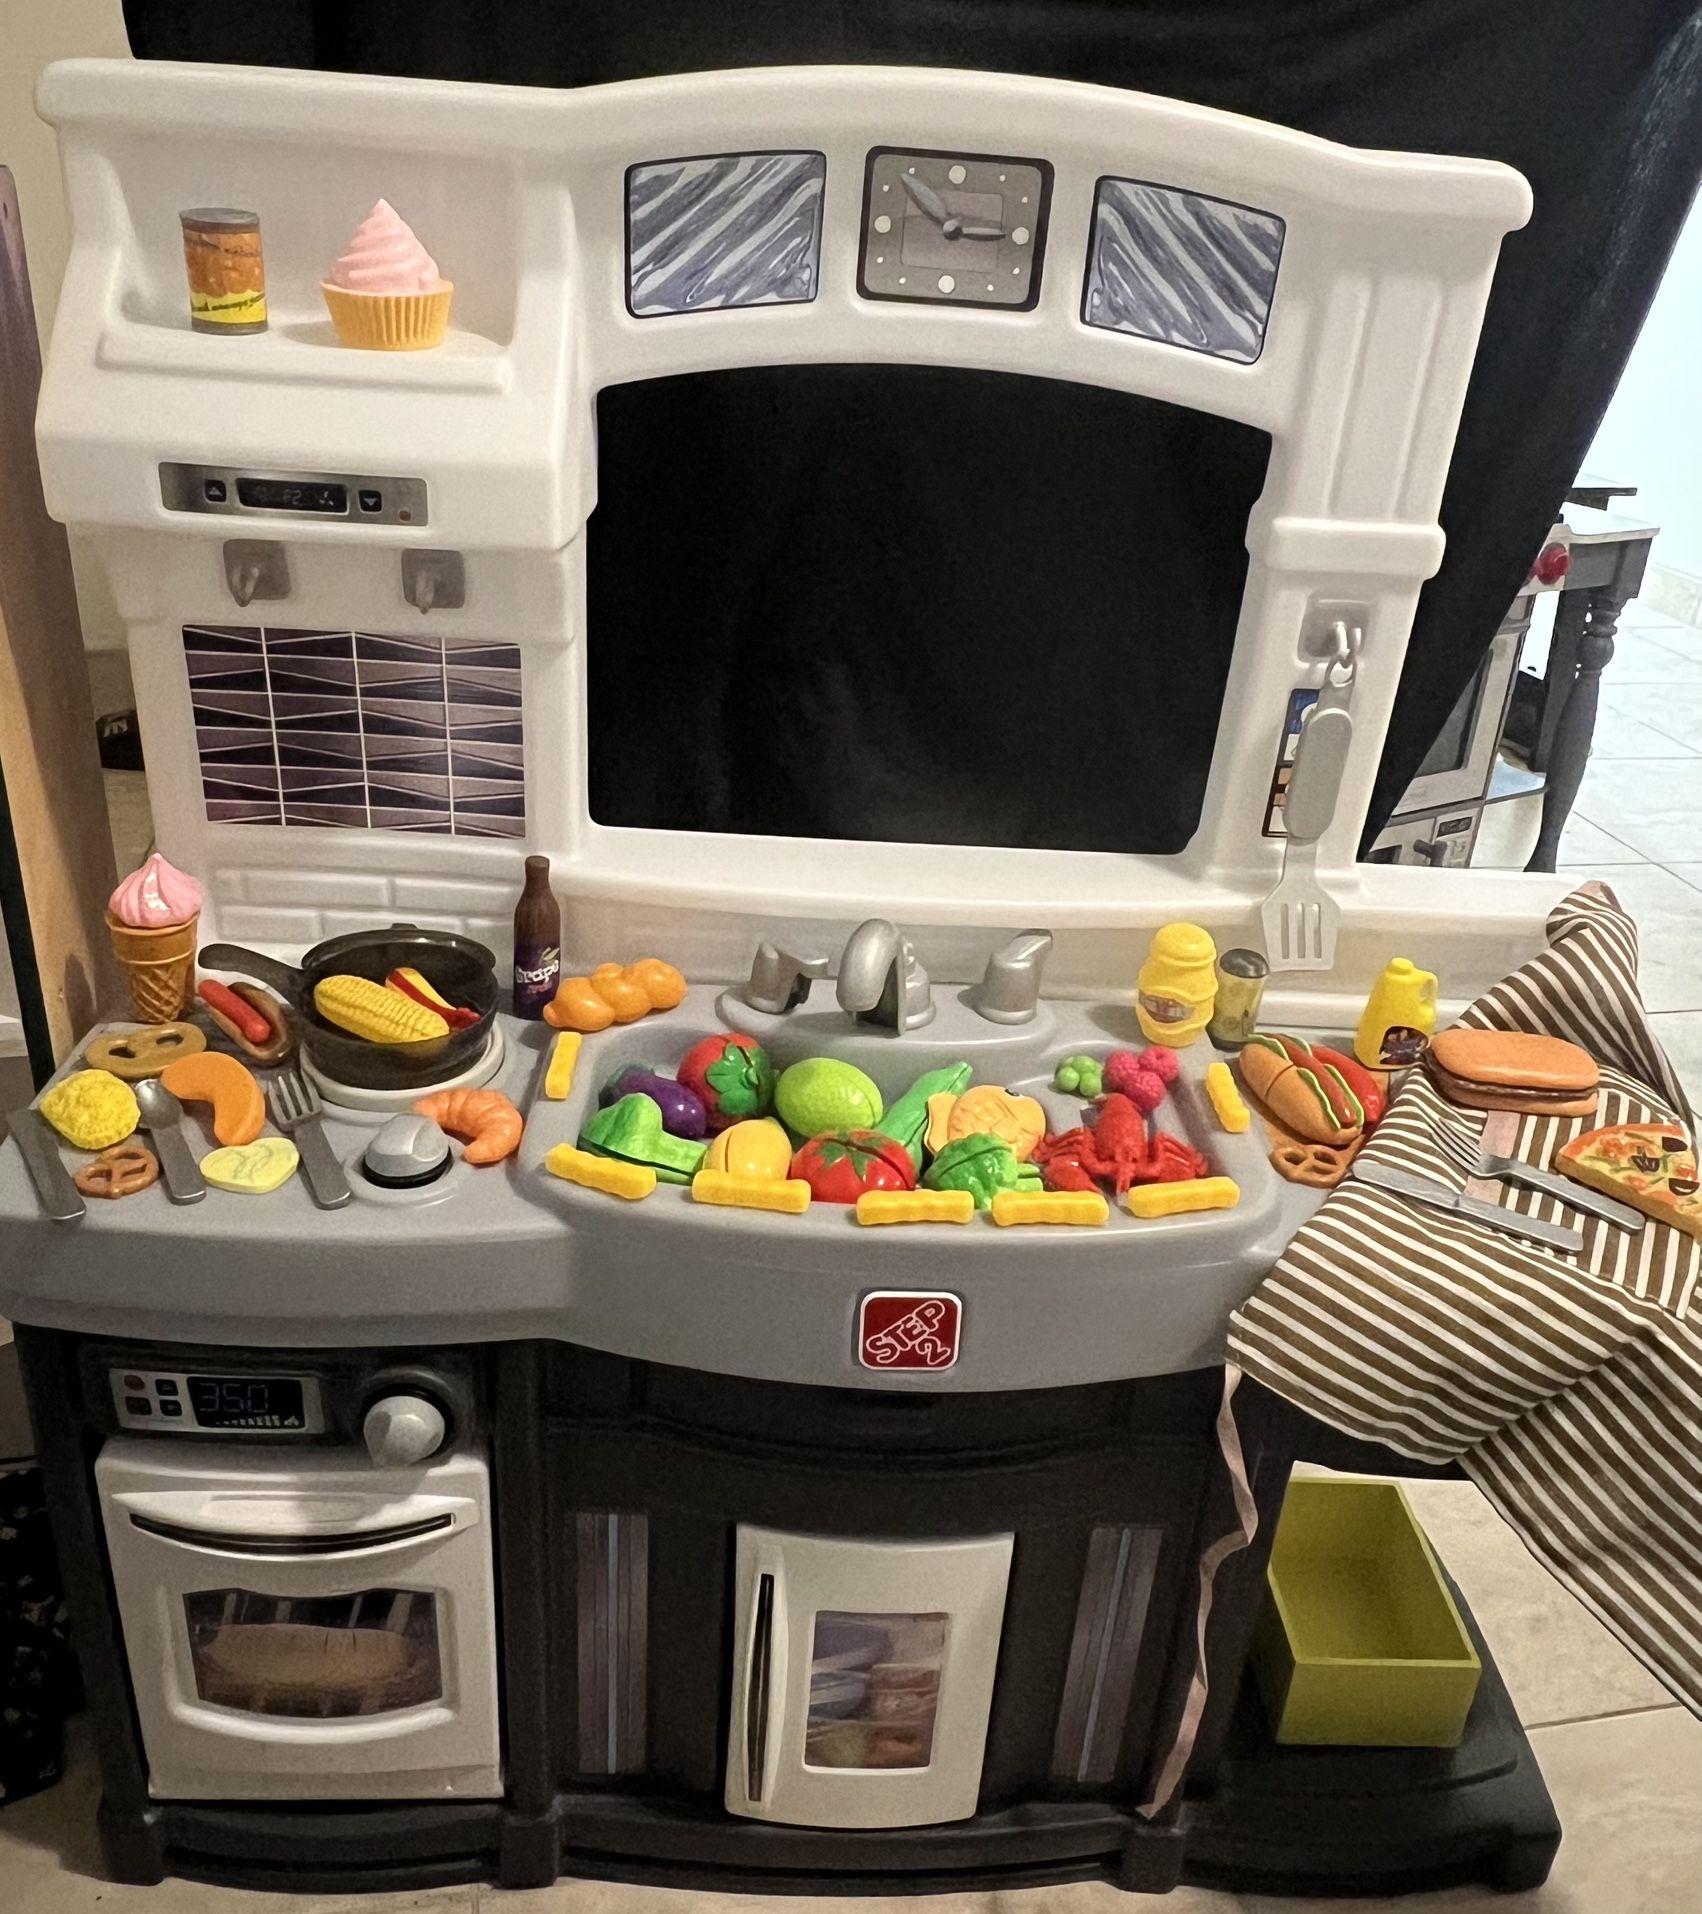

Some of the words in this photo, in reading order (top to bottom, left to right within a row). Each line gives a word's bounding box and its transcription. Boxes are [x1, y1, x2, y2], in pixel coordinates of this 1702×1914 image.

[866, 1300, 945, 1364] STEP
[915, 1336, 951, 1366] 2
[199, 1382, 269, 1413] 350
